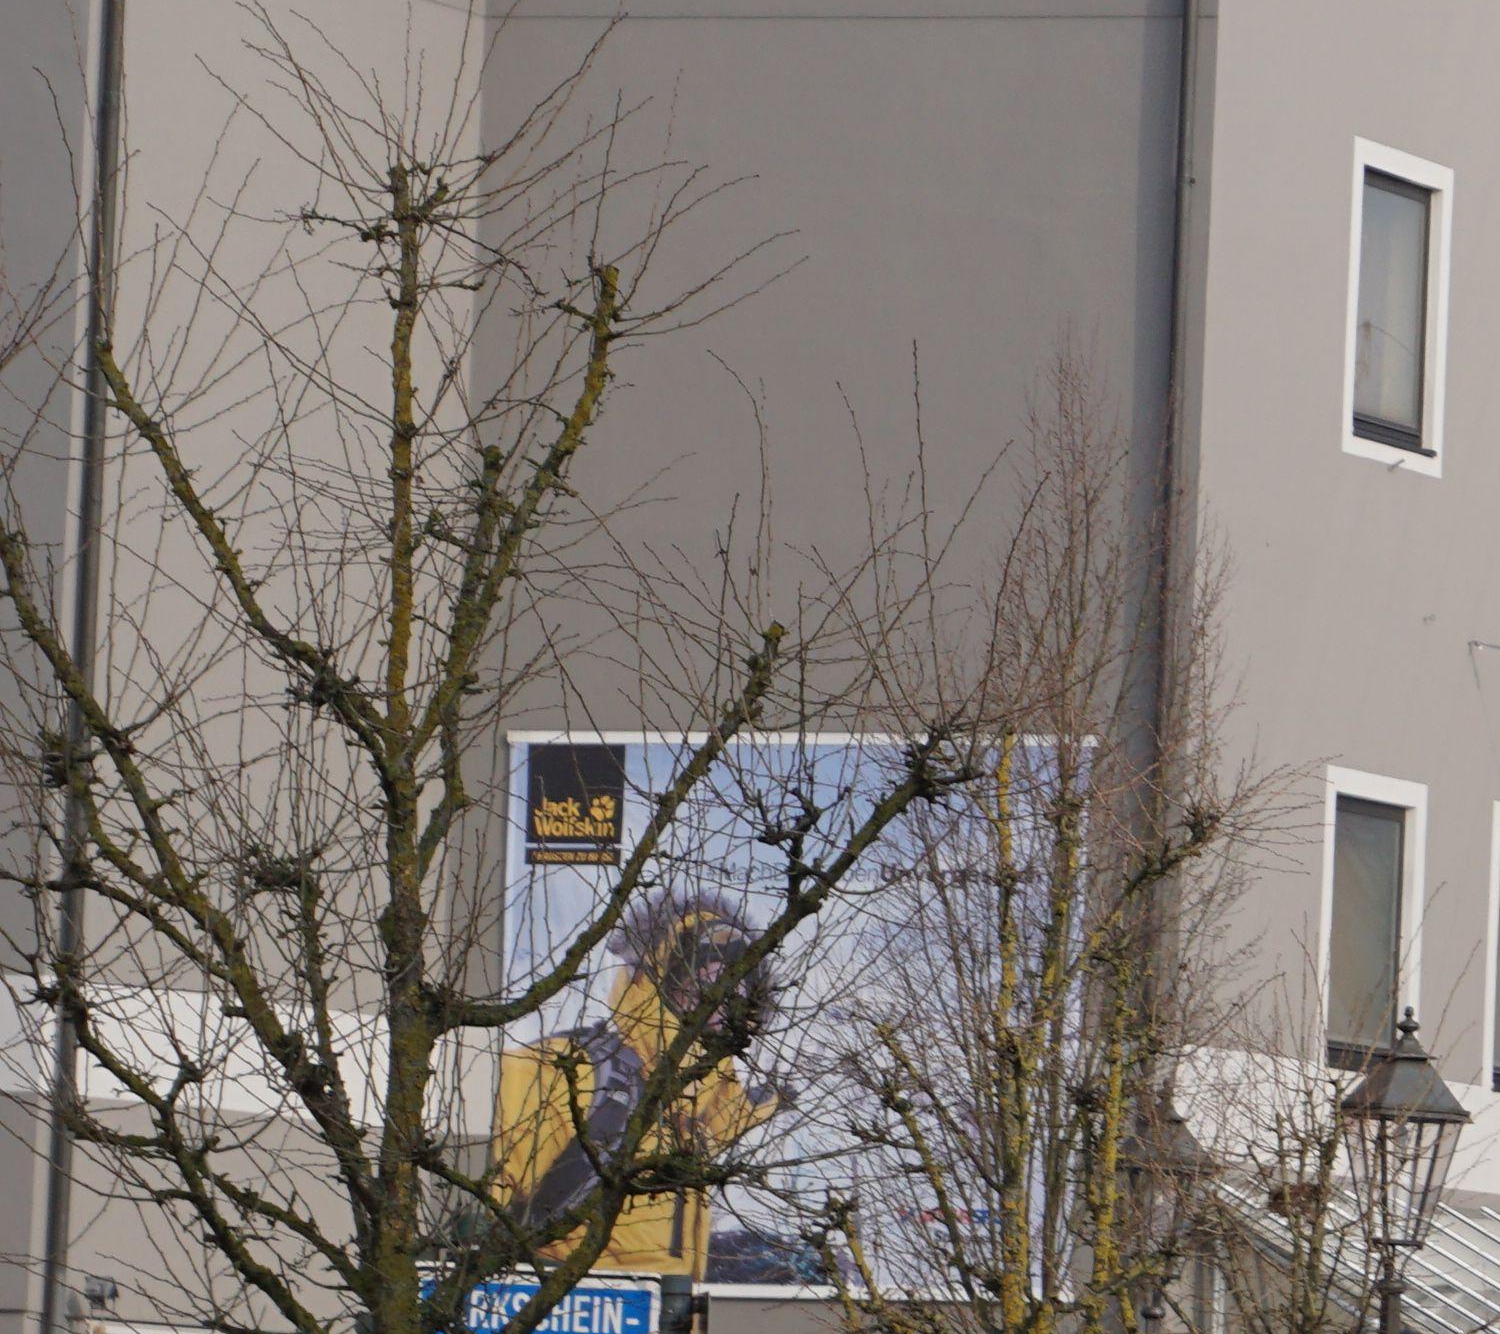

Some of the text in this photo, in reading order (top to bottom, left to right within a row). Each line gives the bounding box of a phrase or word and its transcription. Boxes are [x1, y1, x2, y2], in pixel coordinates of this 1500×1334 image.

[534, 796, 581, 817] Jack
[534, 816, 615, 838] Wolfskin
[467, 1289, 640, 1334] RKSHEIN-
